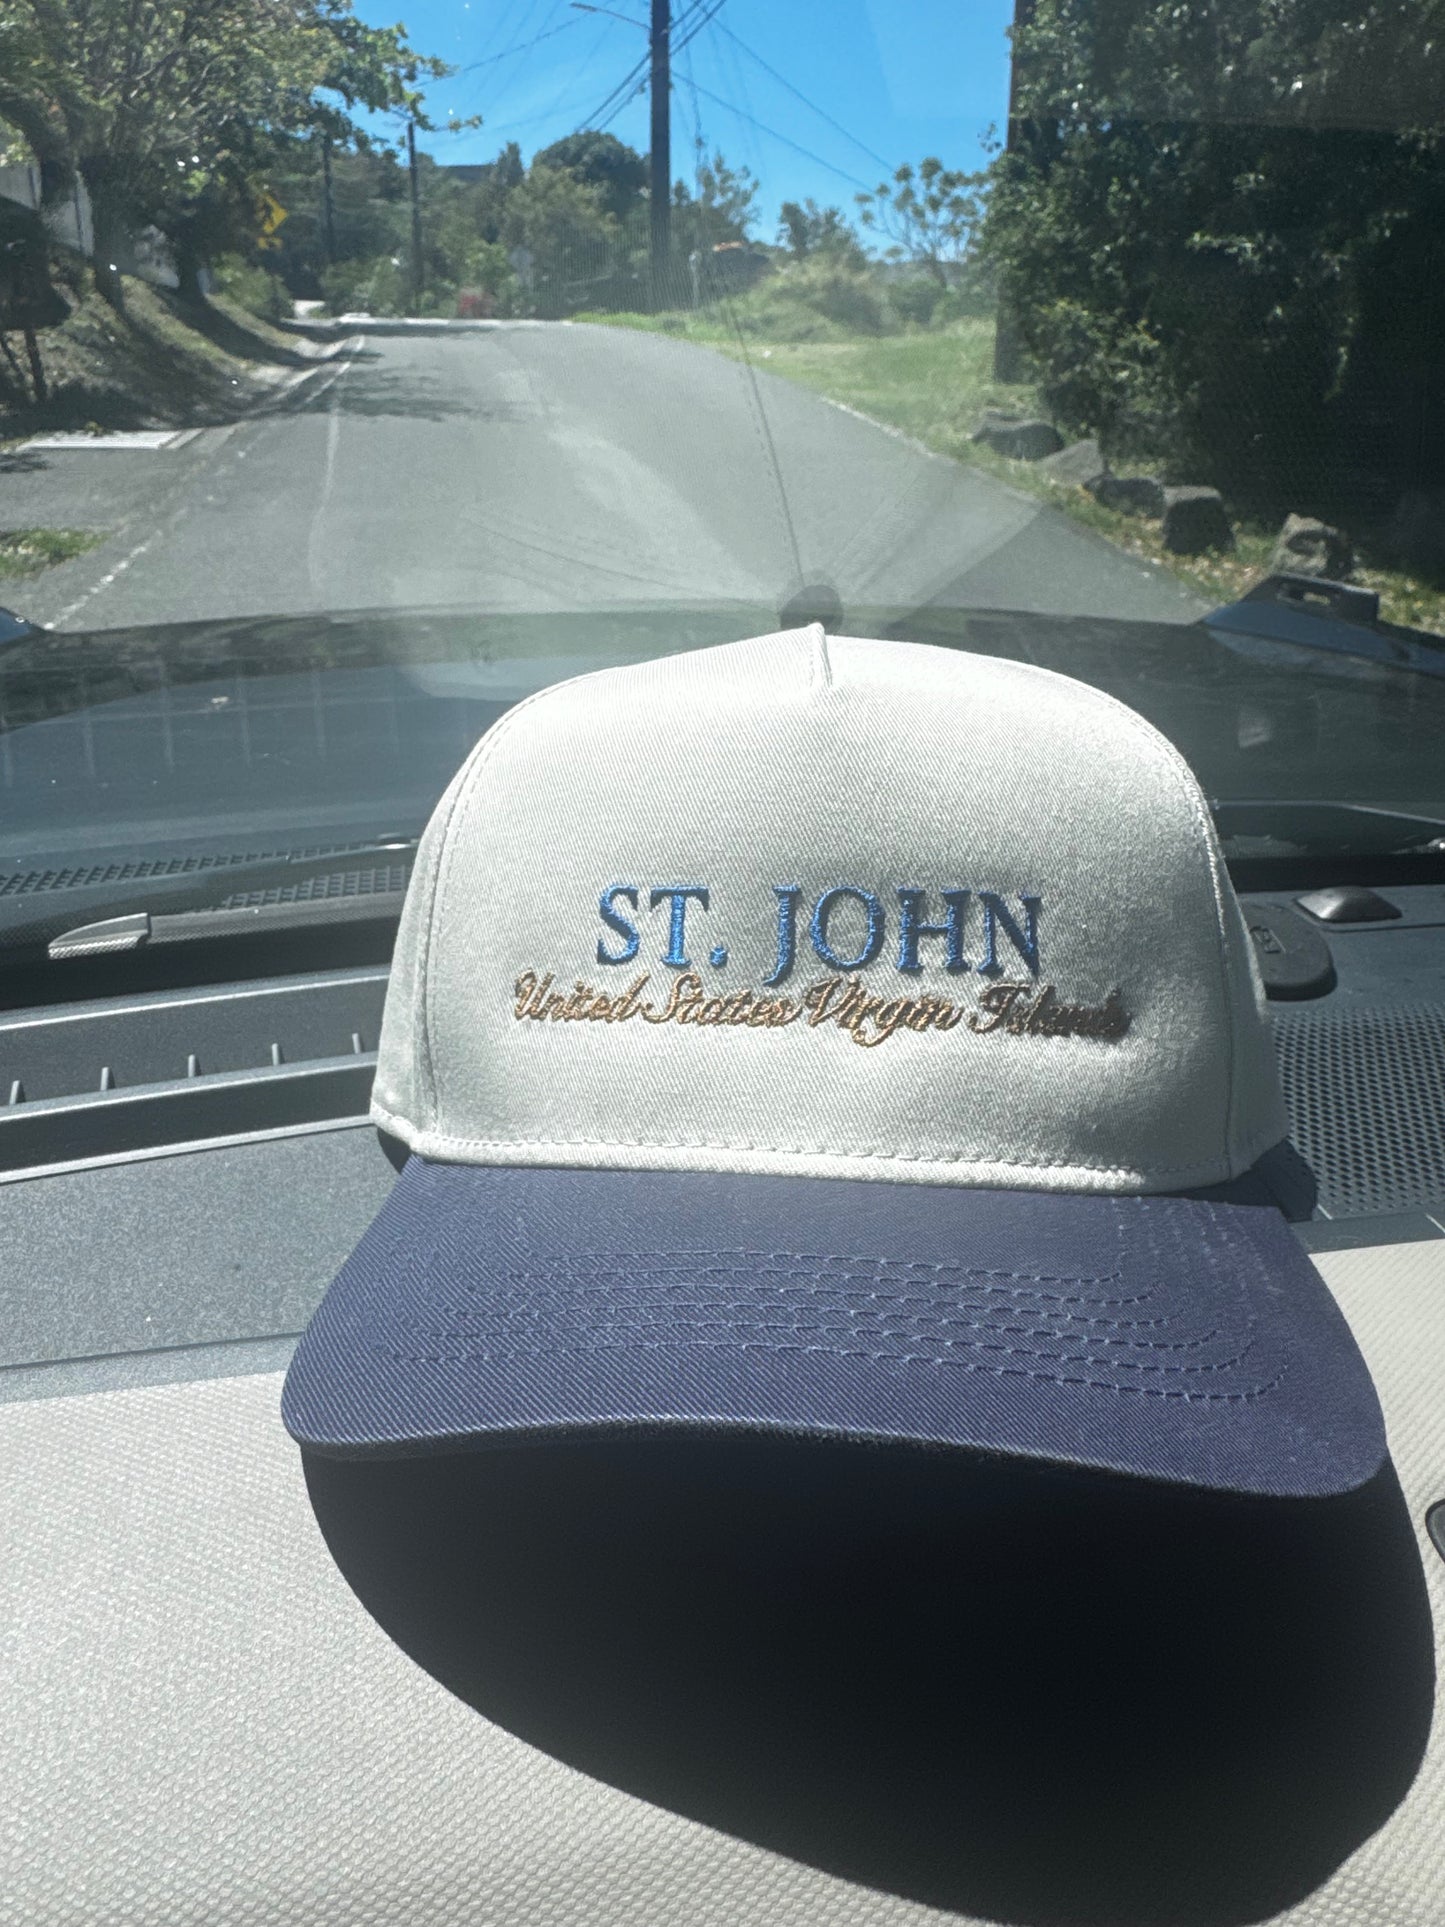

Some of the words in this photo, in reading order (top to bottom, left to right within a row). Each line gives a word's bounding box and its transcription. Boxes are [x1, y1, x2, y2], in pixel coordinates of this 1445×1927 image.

[597, 883, 729, 967] ST.
[763, 884, 1043, 986] JOHN
[514, 968, 648, 1022] United
[644, 972, 800, 1027] States
[803, 974, 963, 1047] Virgin
